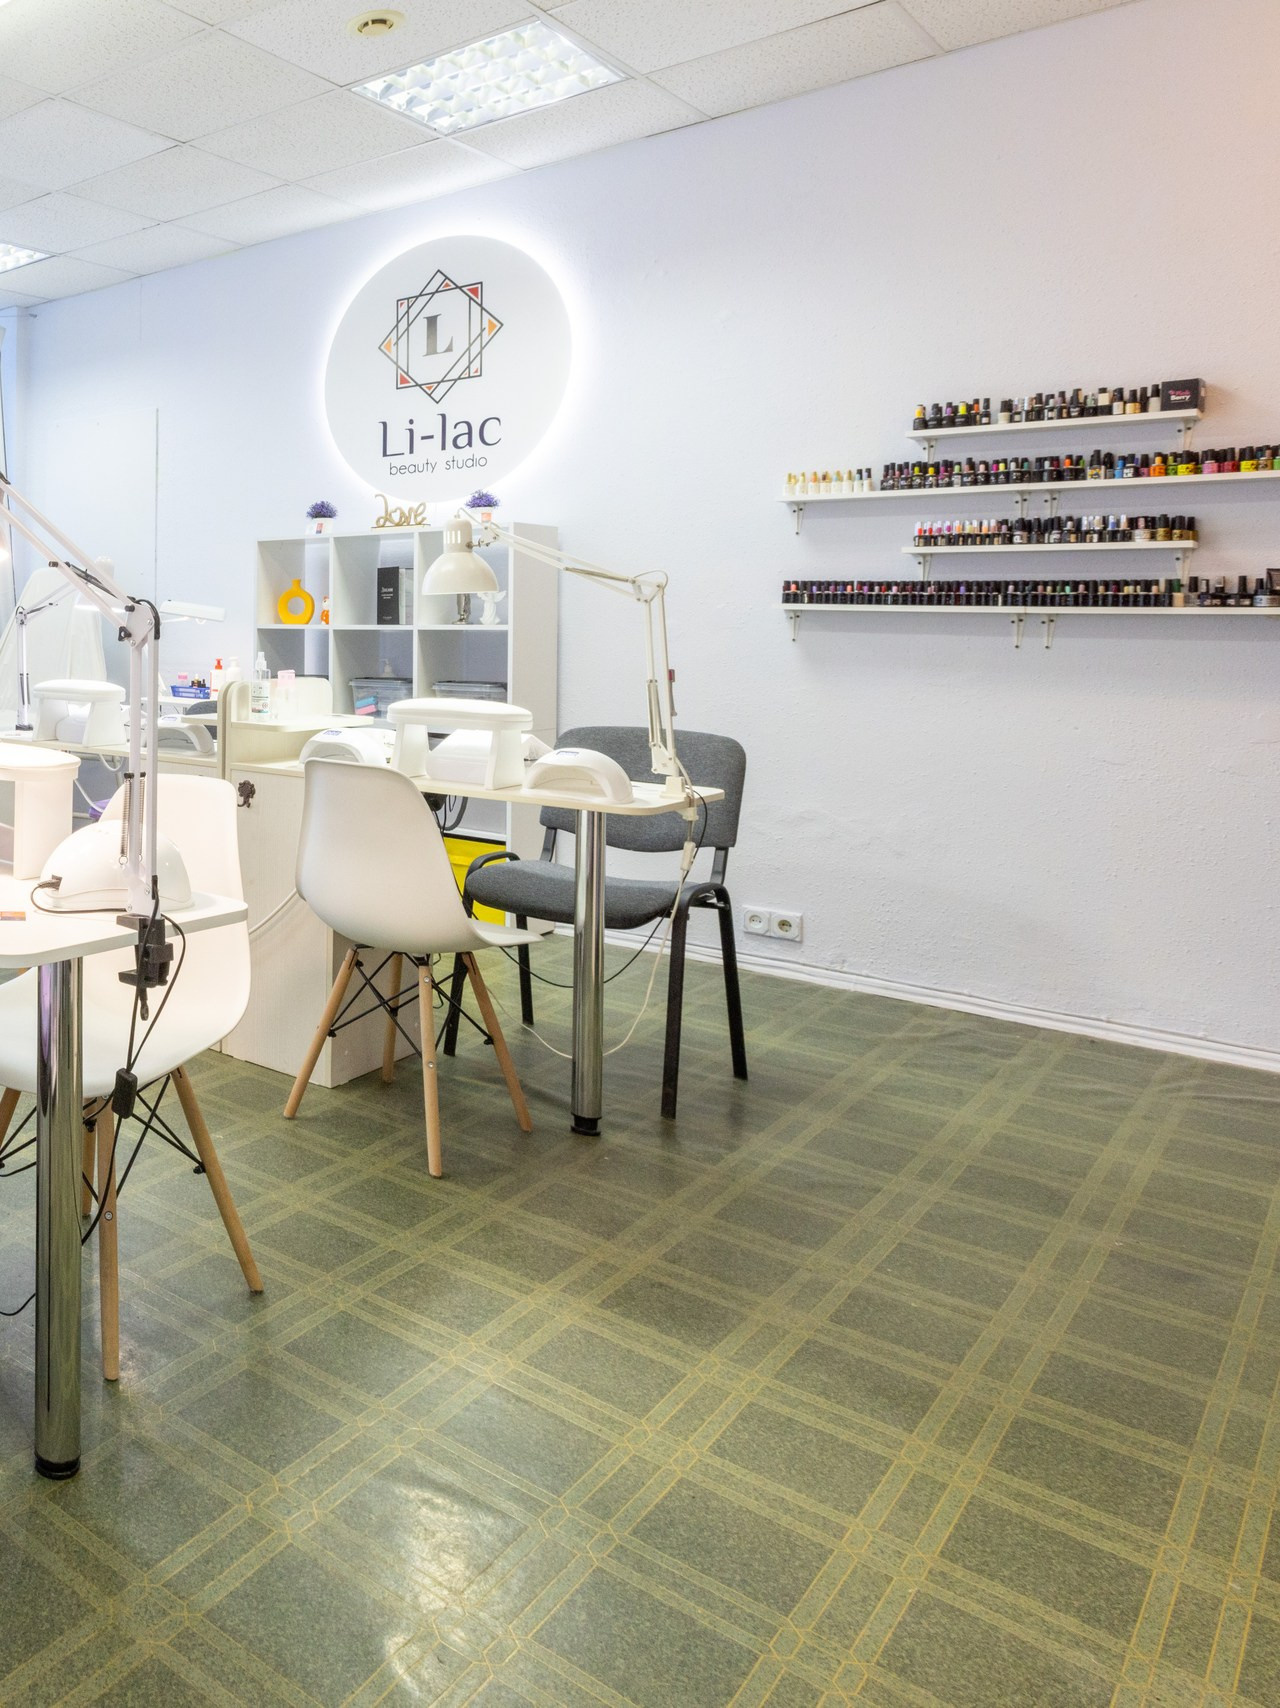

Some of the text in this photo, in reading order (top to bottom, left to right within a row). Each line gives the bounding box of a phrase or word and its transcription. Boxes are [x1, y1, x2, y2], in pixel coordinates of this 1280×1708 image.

[422, 313, 454, 357] L
[378, 413, 502, 458] Li-lac
[389, 453, 488, 476] beauty studio
